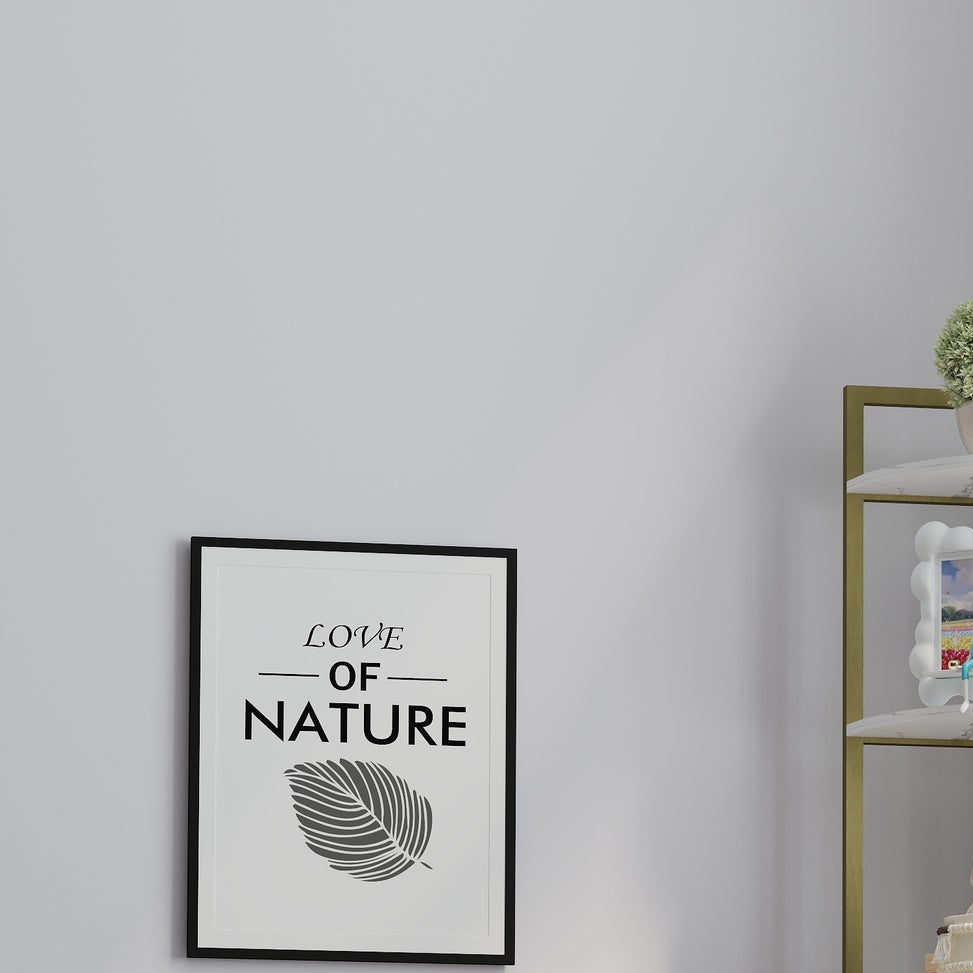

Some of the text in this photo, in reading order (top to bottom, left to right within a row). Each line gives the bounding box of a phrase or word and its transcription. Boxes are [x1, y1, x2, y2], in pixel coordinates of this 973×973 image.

[302, 622, 404, 651] LOVE
[329, 661, 381, 691] OF
[245, 699, 467, 747] NATURE
